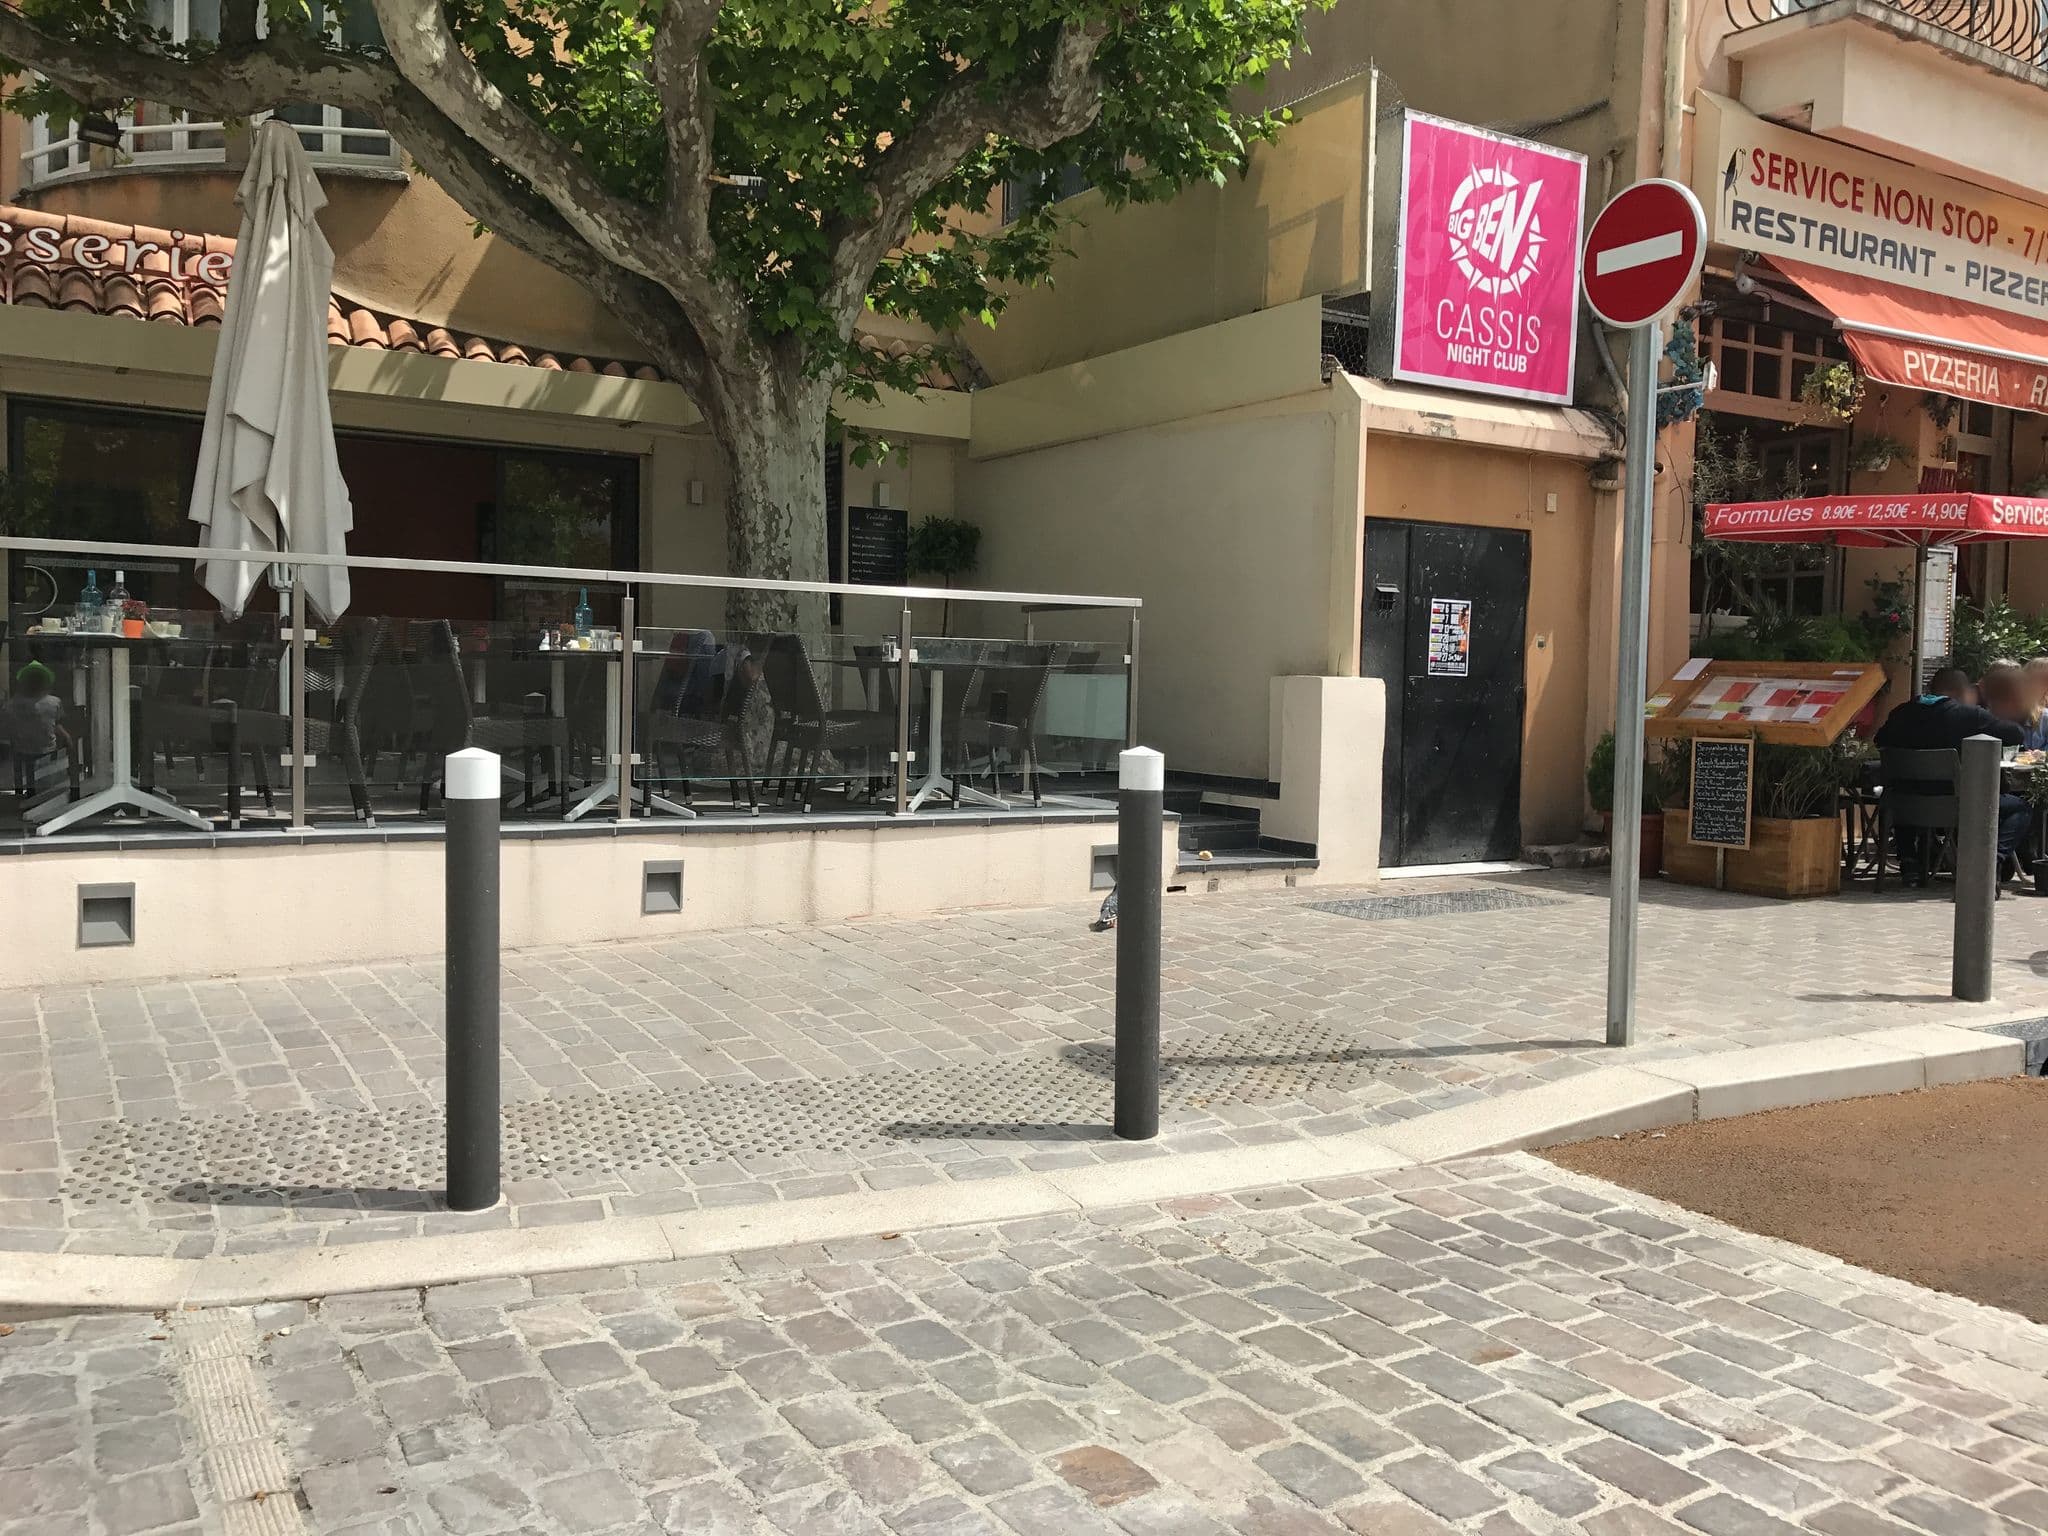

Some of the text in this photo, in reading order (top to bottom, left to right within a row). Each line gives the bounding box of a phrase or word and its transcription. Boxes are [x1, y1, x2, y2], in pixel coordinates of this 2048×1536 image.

[1447, 178, 1544, 273] BIG BEN
[1750, 147, 1864, 213] SERVICE
[1873, 182, 1934, 232] NON
[1942, 201, 1998, 247] STOP
[2023, 226, 2048, 265] 7/
[1731, 199, 1936, 277] RESTAURANT
[1437, 297, 1542, 355] CASSIS
[1446, 342, 1528, 374] NIGHT CLUB
[1903, 350, 2000, 397] PIZZERIA
[2030, 374, 2048, 407] R
[1714, 504, 1814, 526] Formules
[1821, 504, 1857, 520] 8.90€
[1867, 502, 1910, 520] 12,50€
[1921, 502, 1969, 521] 14,90€
